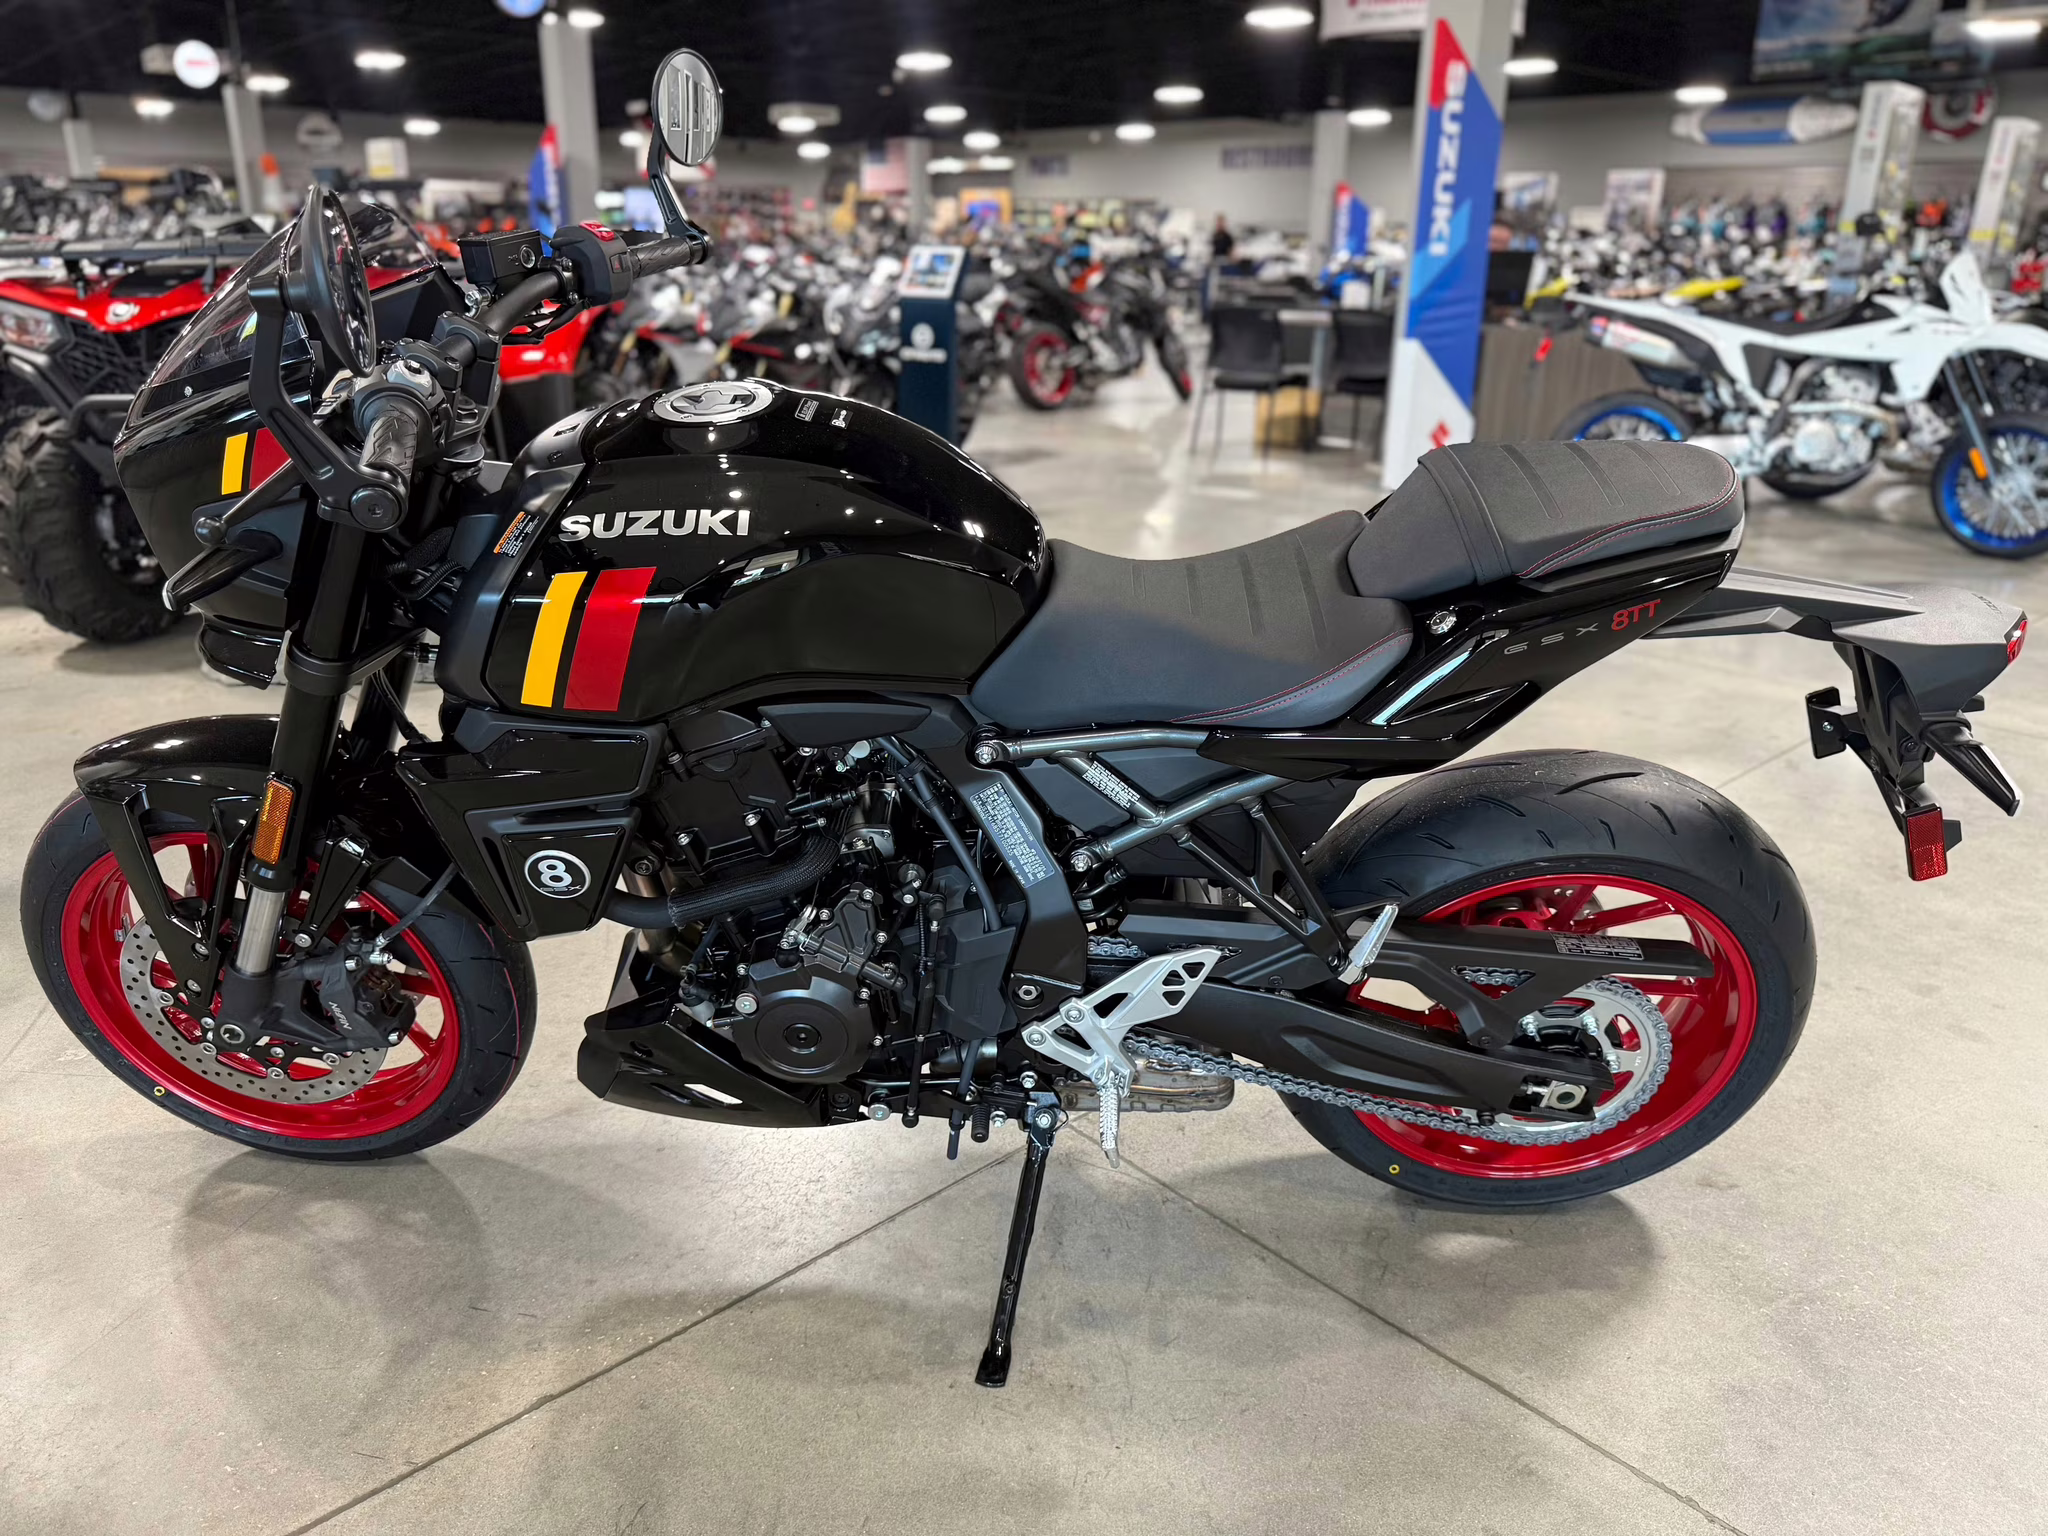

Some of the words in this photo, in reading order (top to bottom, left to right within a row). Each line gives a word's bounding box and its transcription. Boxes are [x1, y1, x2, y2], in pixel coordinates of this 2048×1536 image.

[1427, 59, 1468, 257] SUZUKI
[557, 509, 751, 542] SUZUKI
[1611, 598, 1662, 632] 8TT
[538, 859, 573, 888] 8
